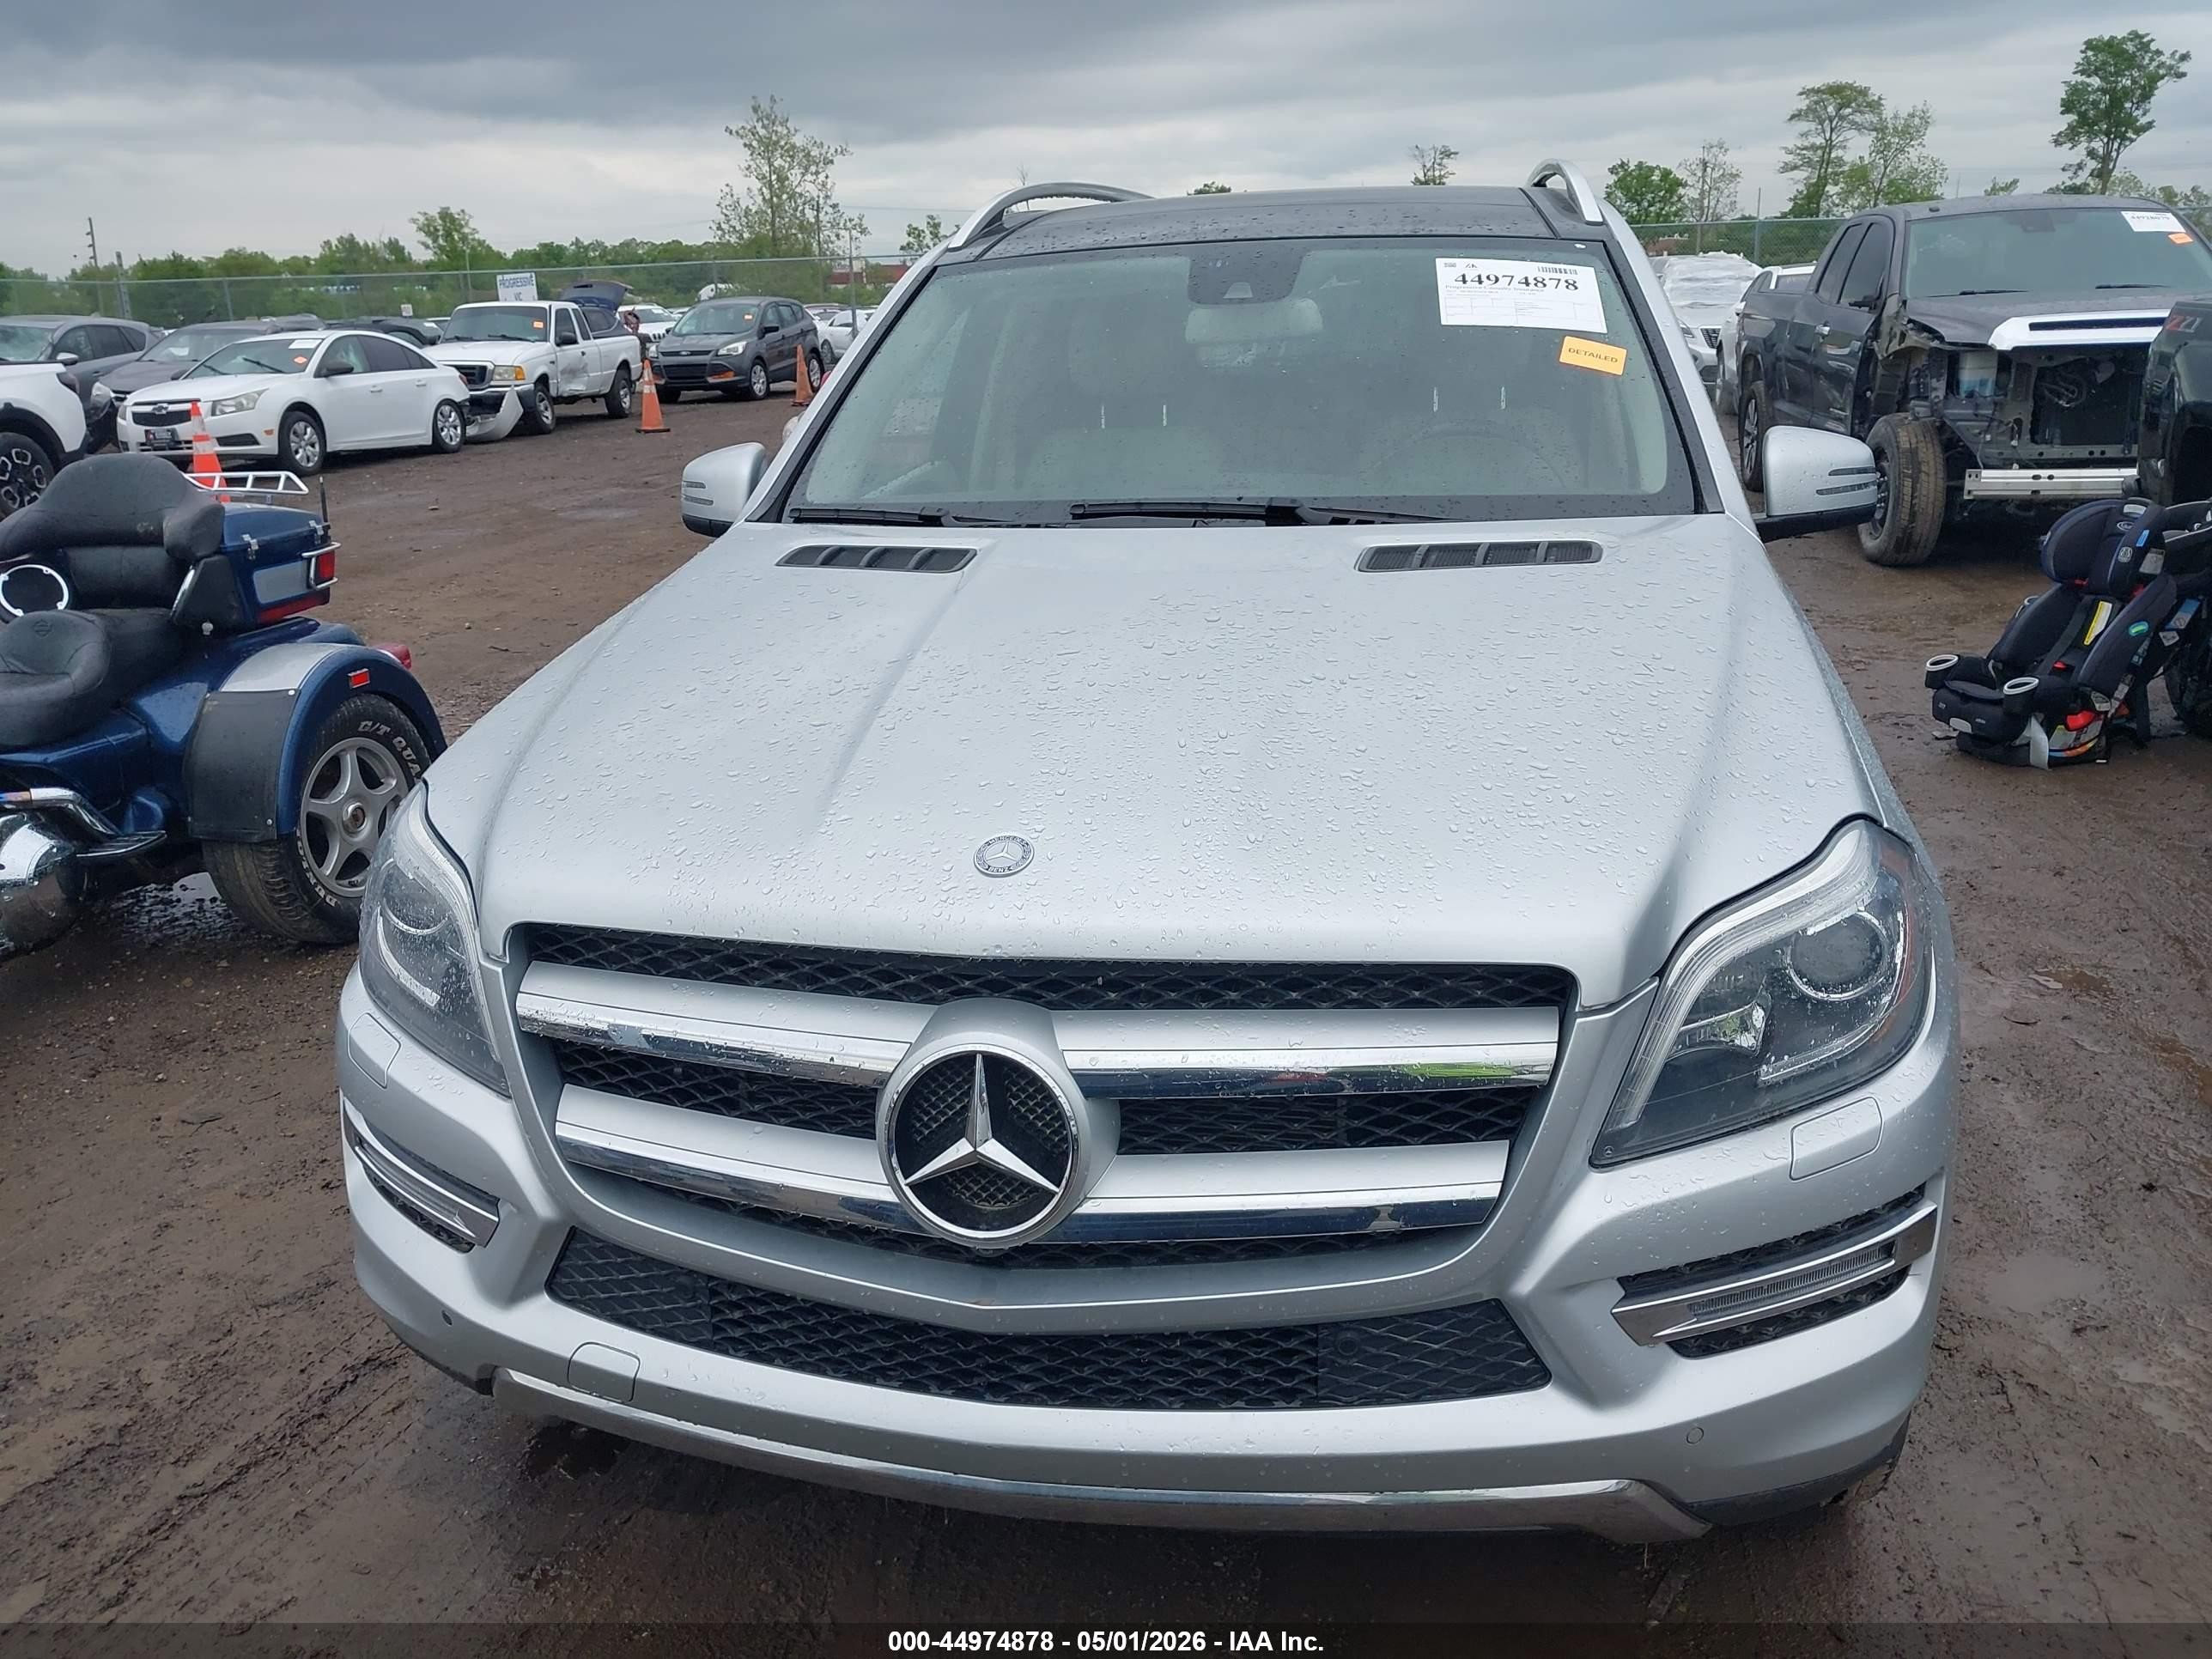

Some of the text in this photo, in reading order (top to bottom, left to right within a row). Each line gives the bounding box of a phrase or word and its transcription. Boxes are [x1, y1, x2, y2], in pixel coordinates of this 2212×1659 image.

[1454, 272, 1579, 290] 44974878
[1568, 347, 1618, 363] DETAILED
[357, 720, 422, 784] G/T QUA
